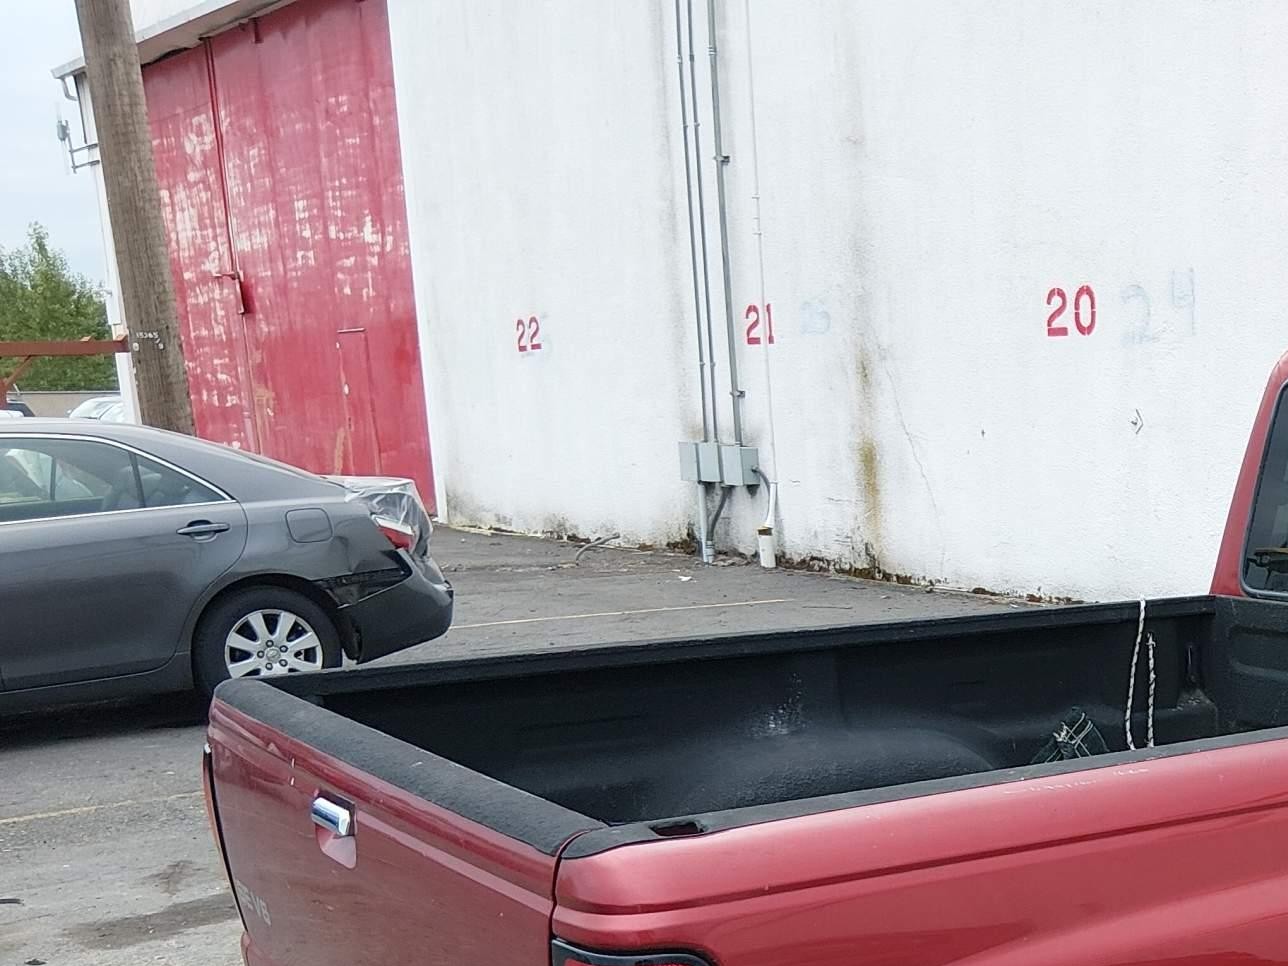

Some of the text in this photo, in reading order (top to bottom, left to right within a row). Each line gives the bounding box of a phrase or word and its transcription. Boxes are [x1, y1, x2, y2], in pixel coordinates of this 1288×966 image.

[744, 303, 775, 345] 21
[1047, 285, 1097, 336] 20
[516, 316, 542, 352] 22
